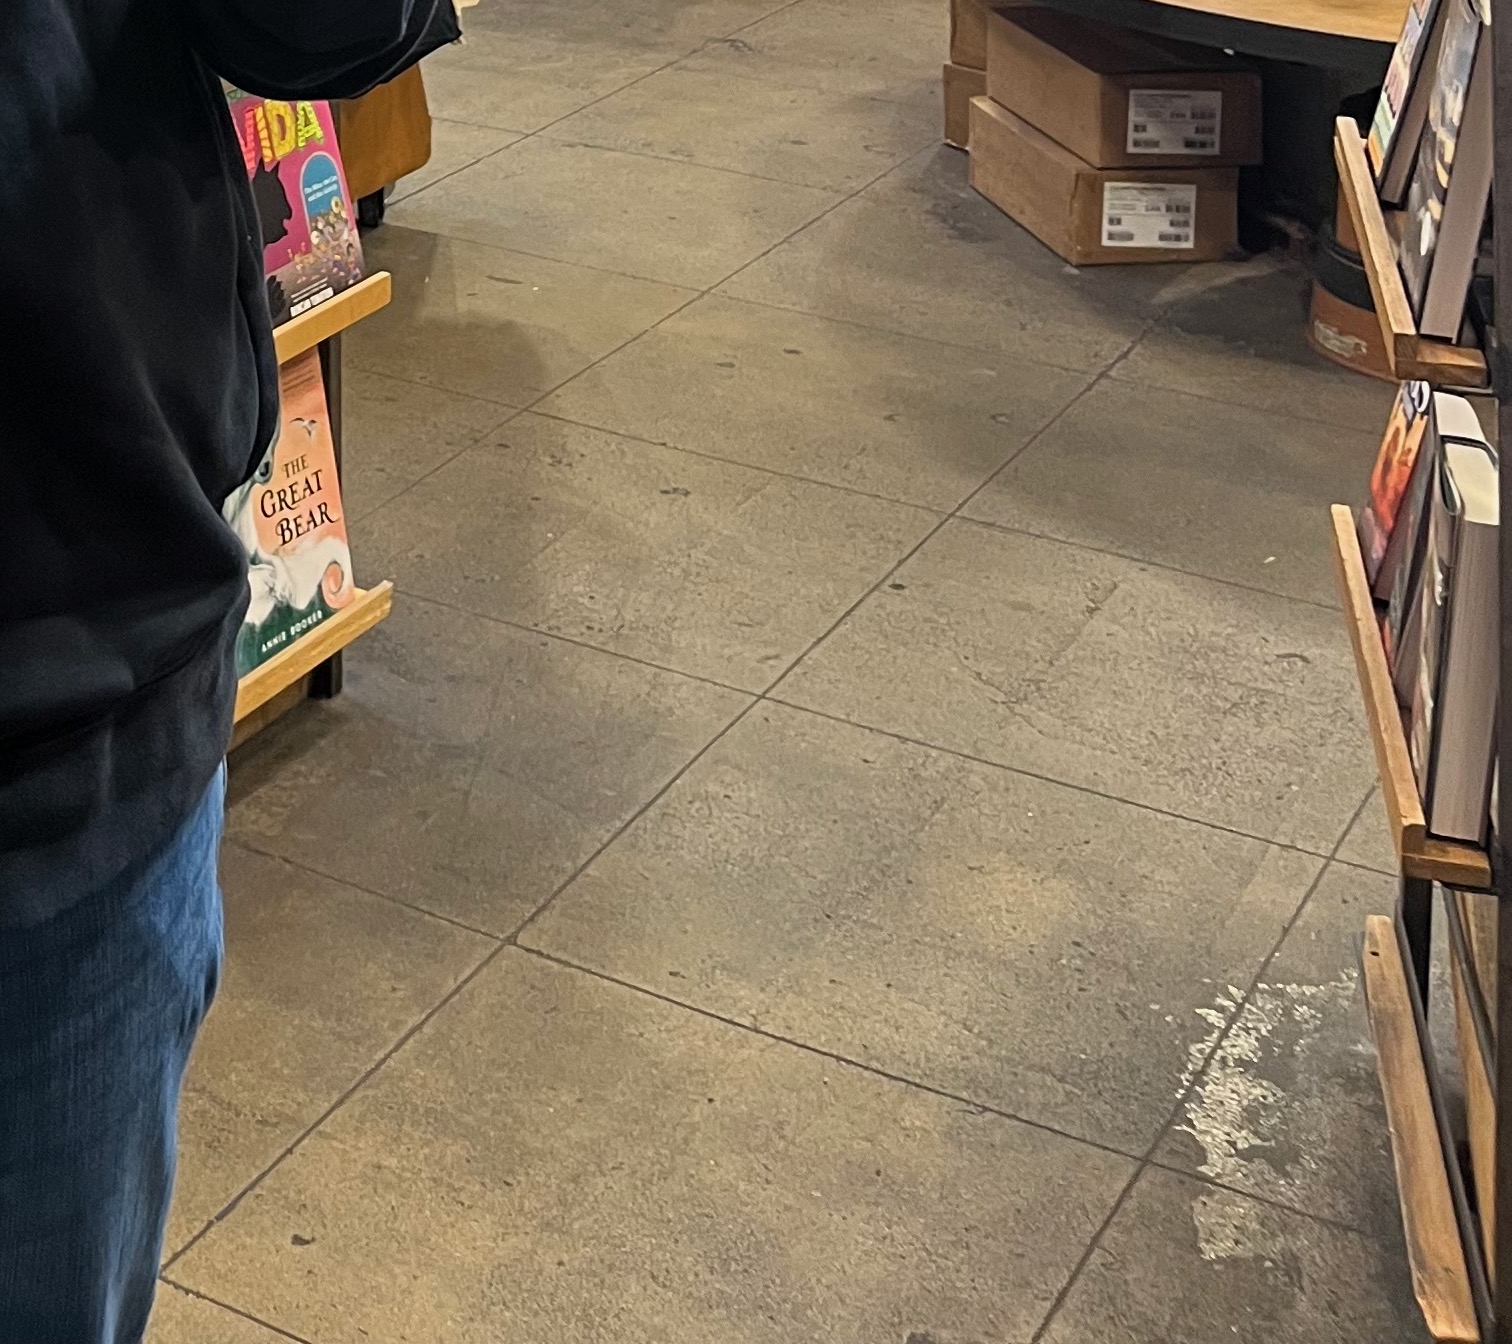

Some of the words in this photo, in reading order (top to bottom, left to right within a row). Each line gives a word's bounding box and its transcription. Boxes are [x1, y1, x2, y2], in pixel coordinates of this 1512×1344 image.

[282, 453, 309, 479] THE
[260, 468, 323, 519] GREAT
[275, 501, 340, 547] BEAR
